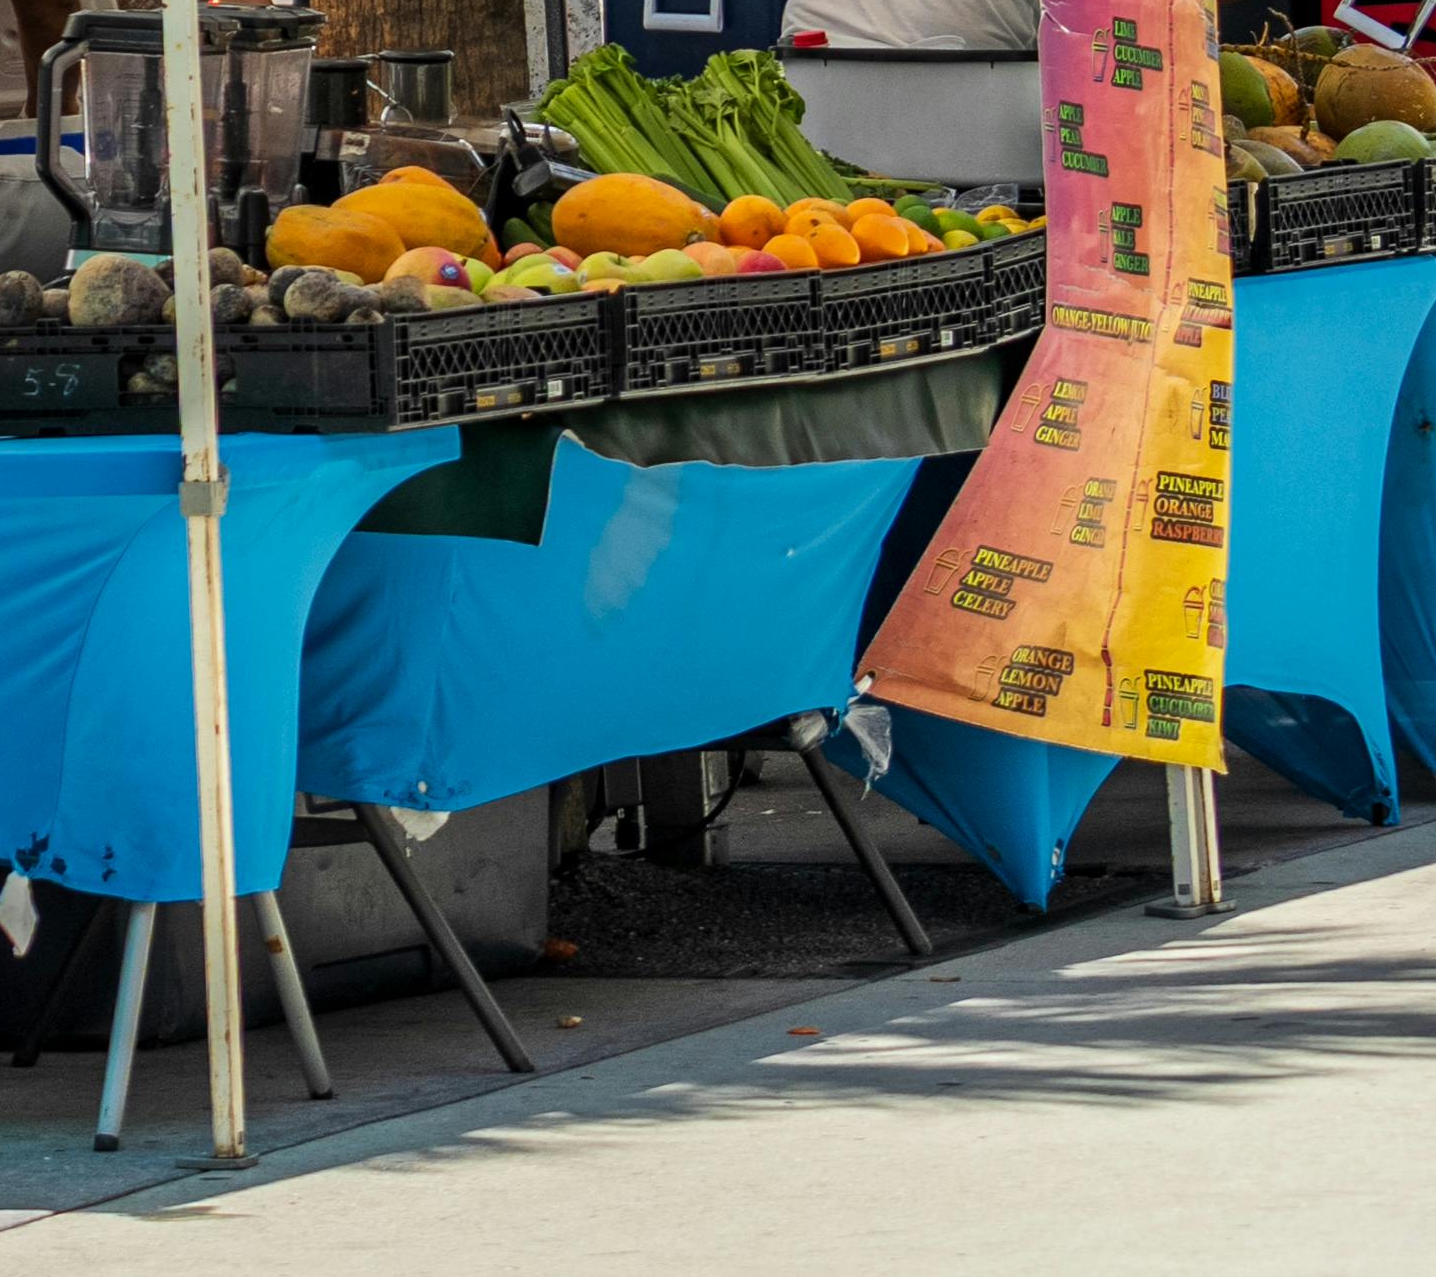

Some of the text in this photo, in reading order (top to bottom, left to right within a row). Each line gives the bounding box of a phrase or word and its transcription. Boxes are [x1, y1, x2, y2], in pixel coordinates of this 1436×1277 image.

[1115, 44, 1163, 68] CUCUMBER
[1113, 69, 1142, 89] APPLE
[1062, 151, 1108, 175] CUCUMBER
[1112, 205, 1141, 226] APPLE
[1042, 404, 1078, 424] APPLE
[1035, 425, 1080, 449] GINGER
[1158, 473, 1224, 499] PINEAPPLE
[1155, 498, 1213, 520] ORANGE
[973, 548, 1052, 582] PINEAPPLE
[961, 569, 1013, 595] APPLE
[953, 590, 1015, 619] CELERY
[1011, 646, 1073, 673] ORANGE
[1000, 667, 1062, 694] LEMON
[1147, 673, 1214, 697] PINEAPPLE
[996, 689, 1045, 716] APPLE
